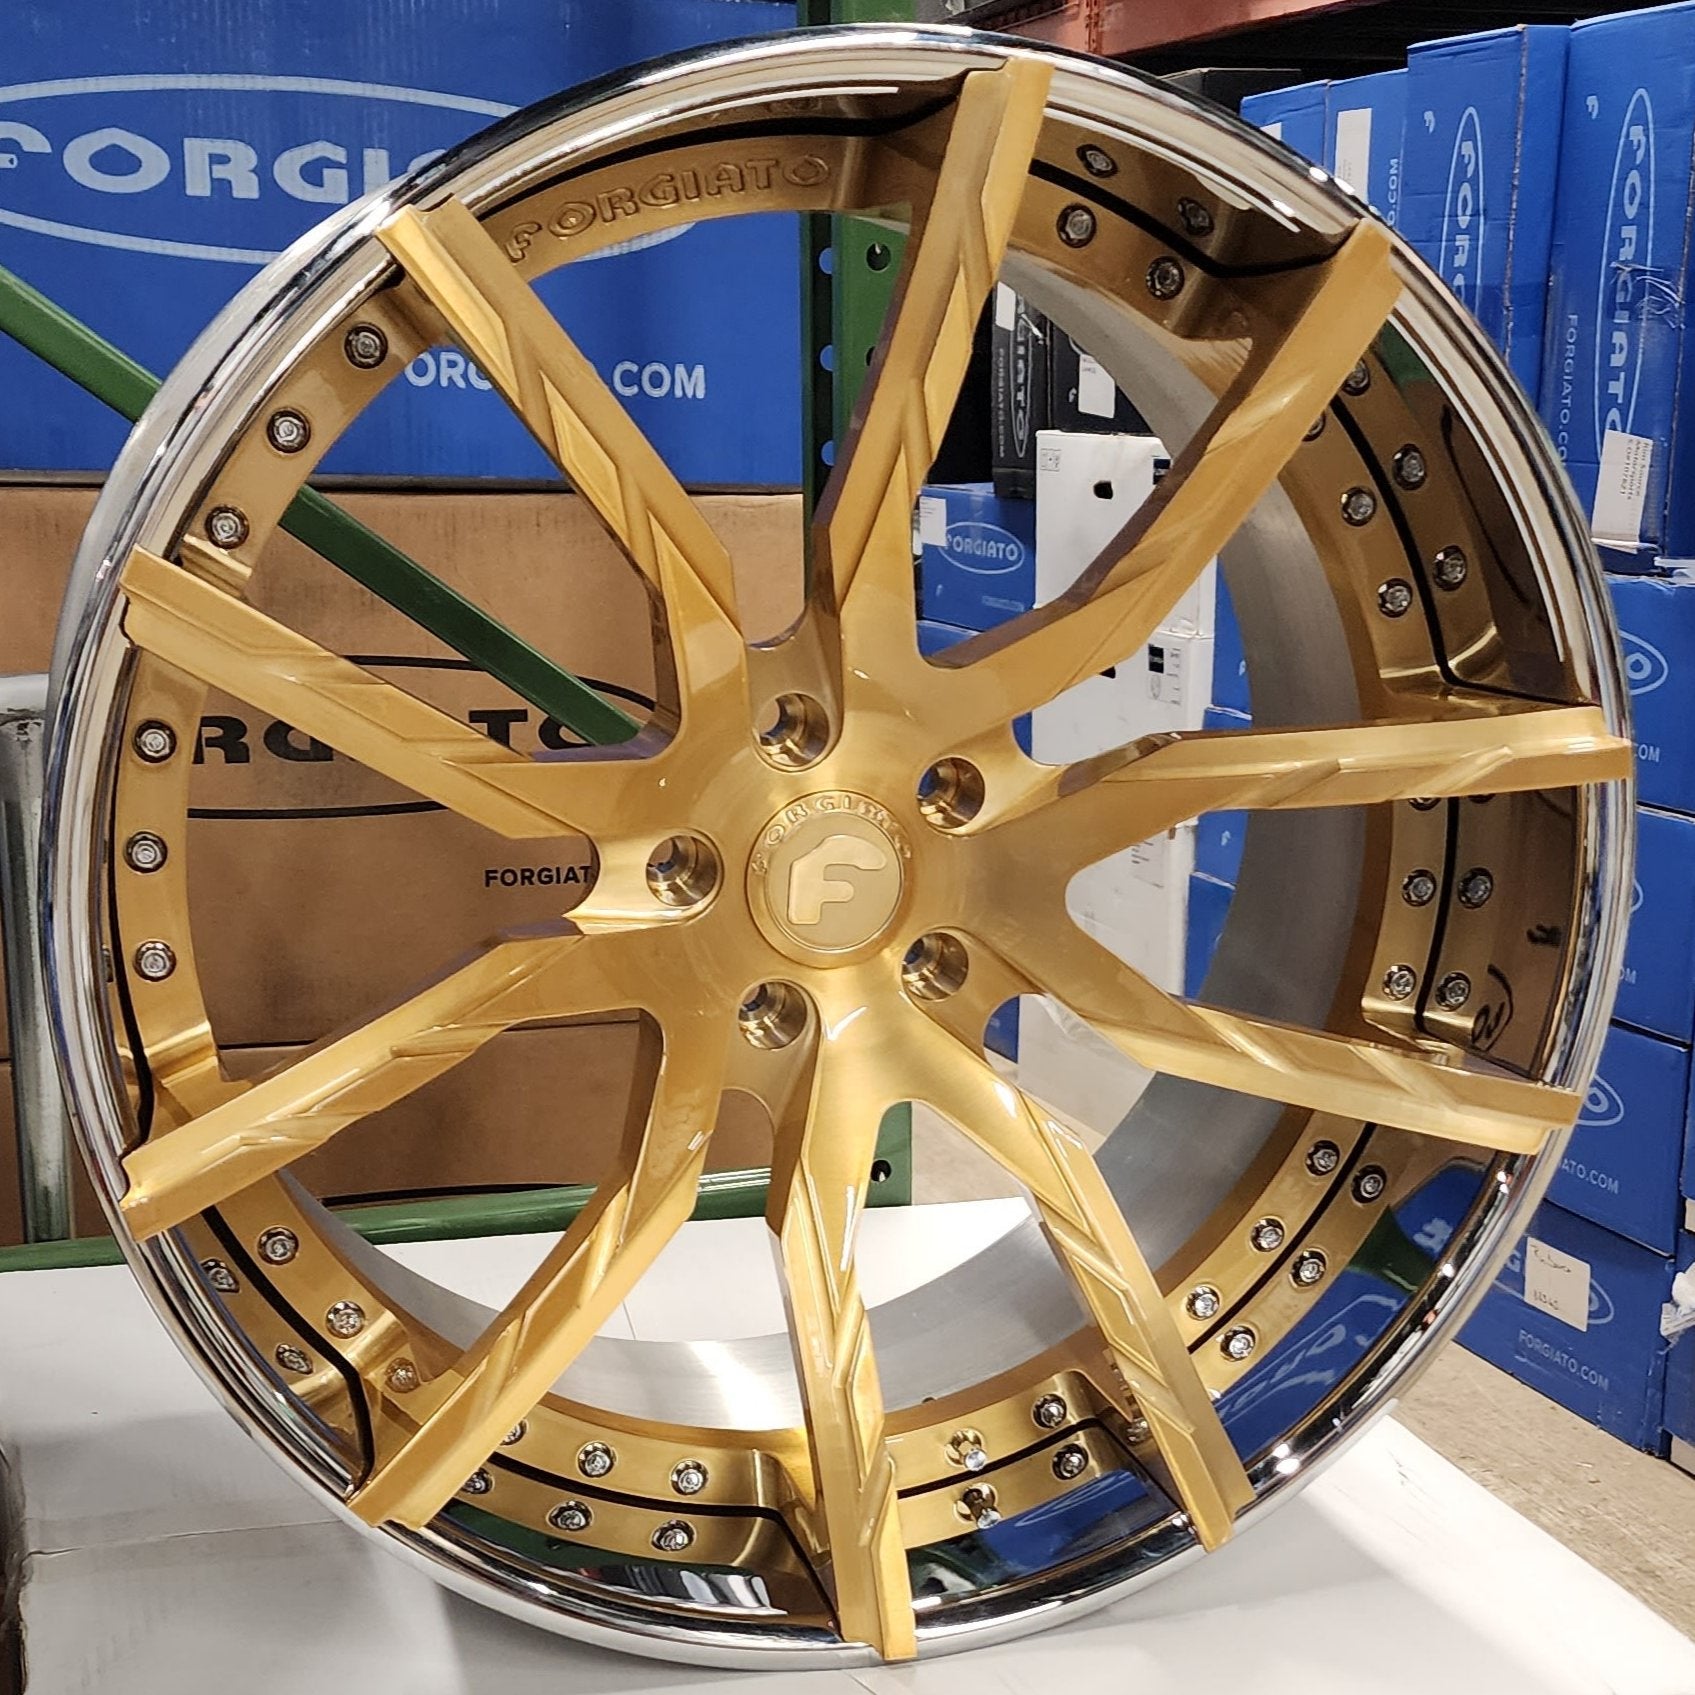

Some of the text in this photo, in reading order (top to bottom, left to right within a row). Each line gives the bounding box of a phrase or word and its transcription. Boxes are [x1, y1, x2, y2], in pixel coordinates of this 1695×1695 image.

[0, 120, 448, 204] FORGI
[503, 154, 830, 263] FORGIATO
[1558, 314, 1579, 465] FORGIATO.CO
[945, 534, 1018, 561] ORGIATO
[786, 833, 888, 925] F
[1559, 1158, 1618, 1195] ATO.COM
[1518, 1328, 1609, 1391] FORGIATO.COM
